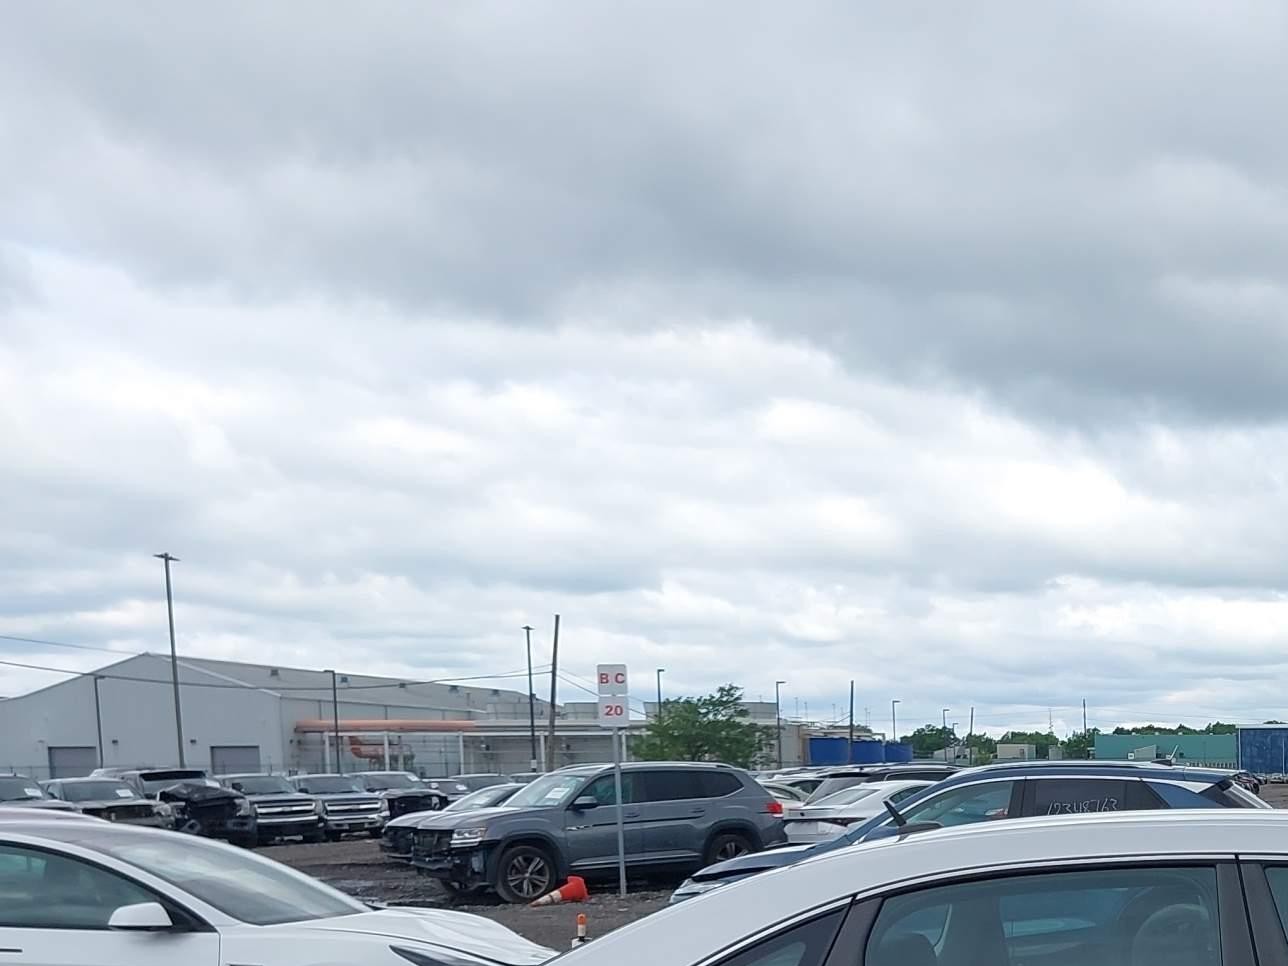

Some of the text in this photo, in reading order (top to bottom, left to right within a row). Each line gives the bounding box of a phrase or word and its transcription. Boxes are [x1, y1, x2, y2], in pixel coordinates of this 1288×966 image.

[600, 672, 625, 684] B C
[604, 704, 624, 716] 20
